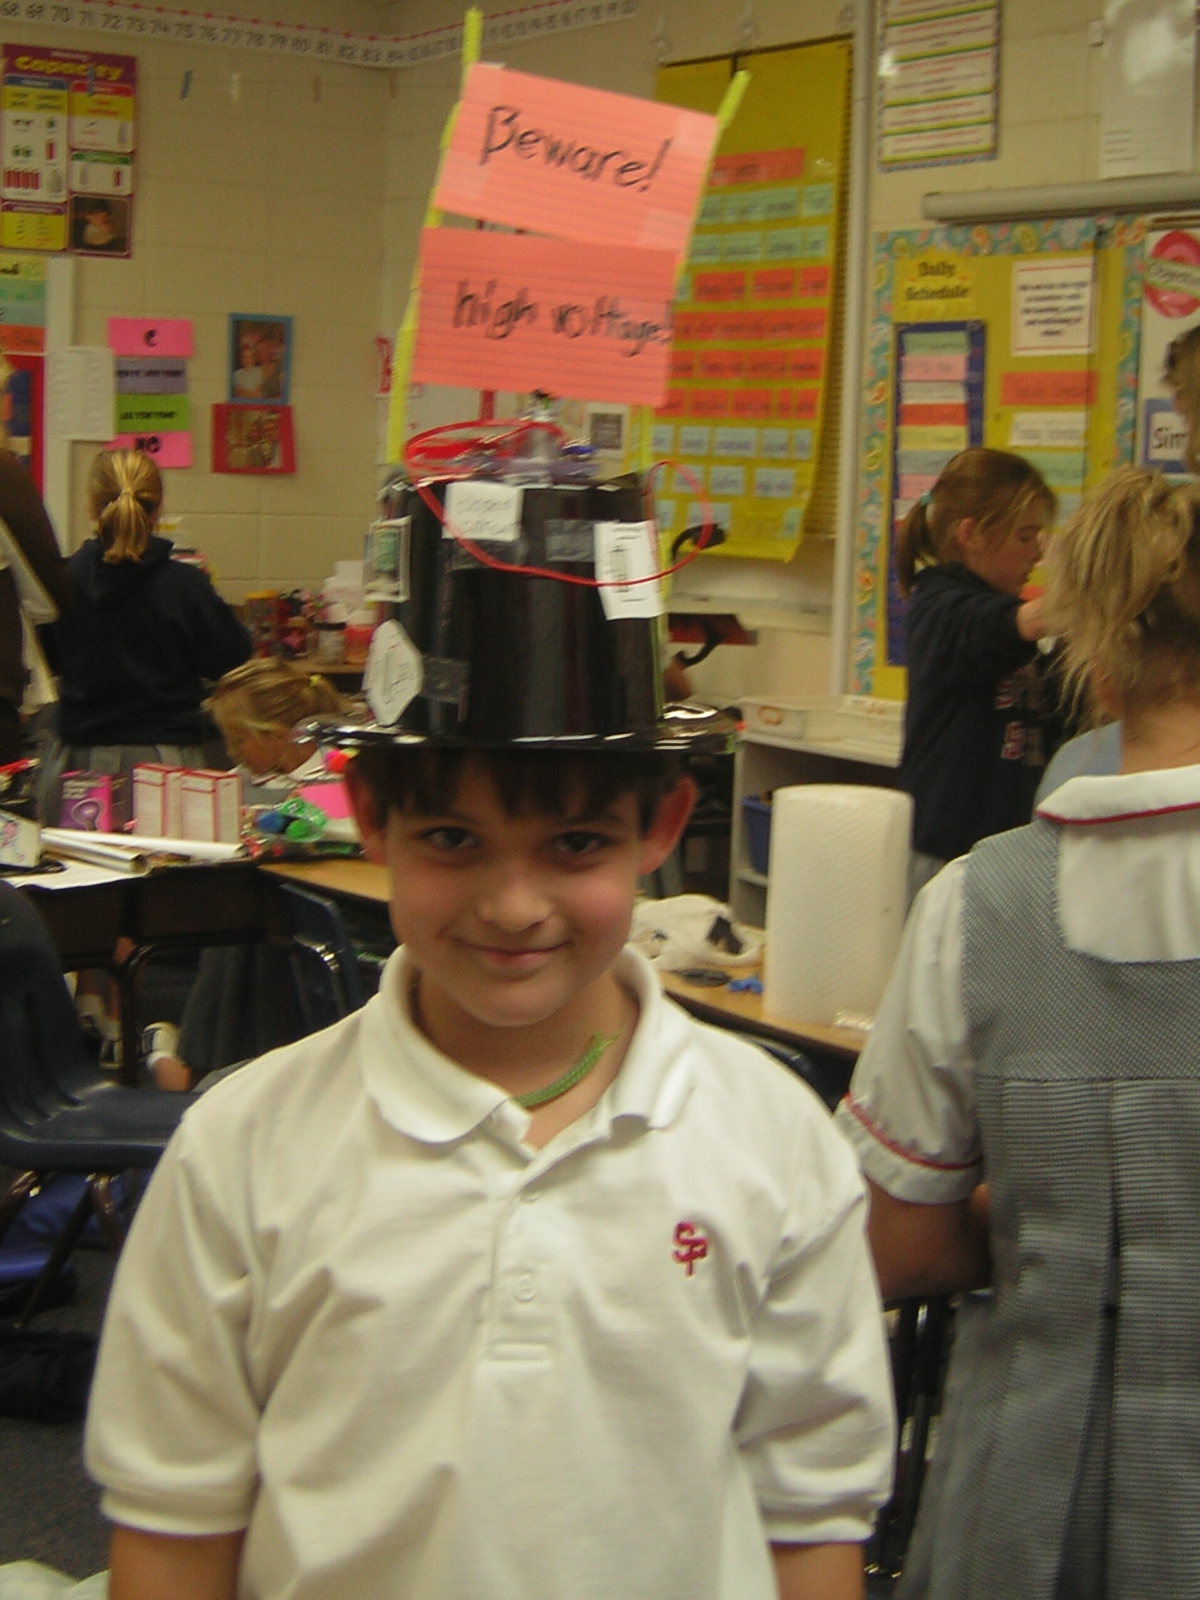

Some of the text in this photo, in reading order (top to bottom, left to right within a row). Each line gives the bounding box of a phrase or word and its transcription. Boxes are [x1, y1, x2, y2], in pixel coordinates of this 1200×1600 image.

[50, 6, 71, 23] 70
[101, 13, 121, 30] 72
[126, 16, 146, 33] 73
[174, 22, 195, 39] 75
[199, 25, 218, 42] 76
[222, 28, 243, 45] 77
[14, 55, 124, 81] Capacty
[480, 105, 674, 193] Beware!
[918, 261, 956, 279] Daily
[905, 285, 970, 302] Schedule
[452, 279, 538, 341] high
